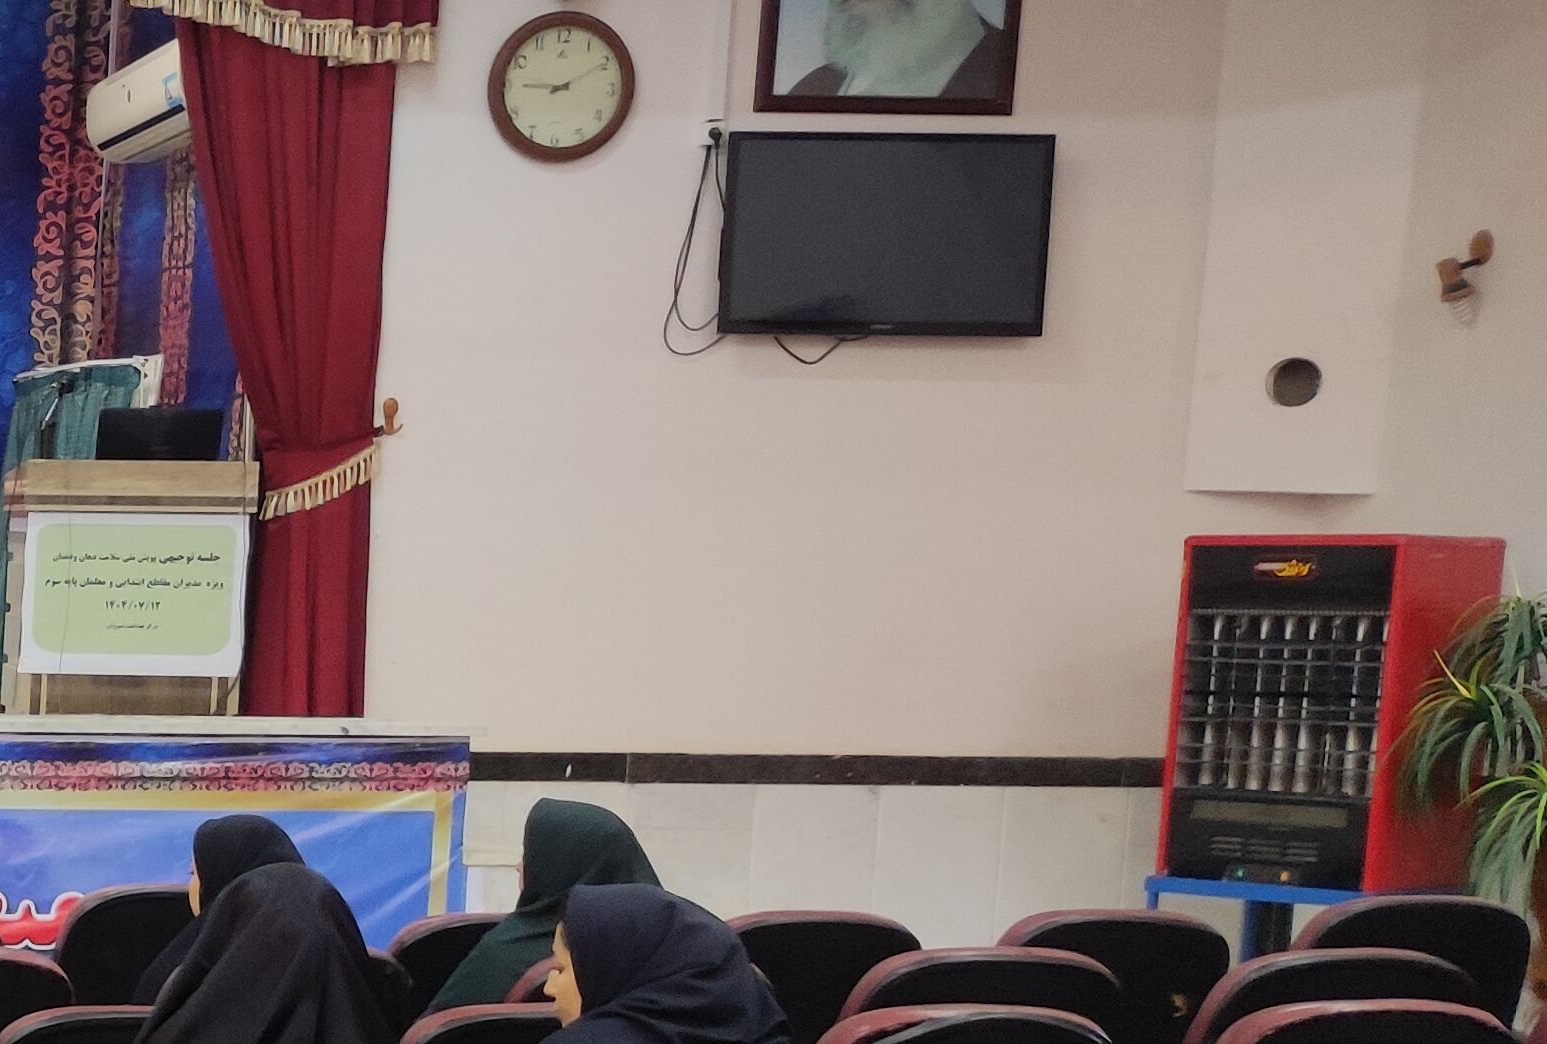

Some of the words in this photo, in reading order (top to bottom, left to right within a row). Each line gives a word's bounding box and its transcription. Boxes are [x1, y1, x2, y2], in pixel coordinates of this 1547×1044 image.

[535, 34, 545, 51] 11
[557, 28, 572, 44] 12
[514, 54, 527, 70] 10
[600, 55, 610, 71] 2
[196, 552, 221, 562] جلسه
